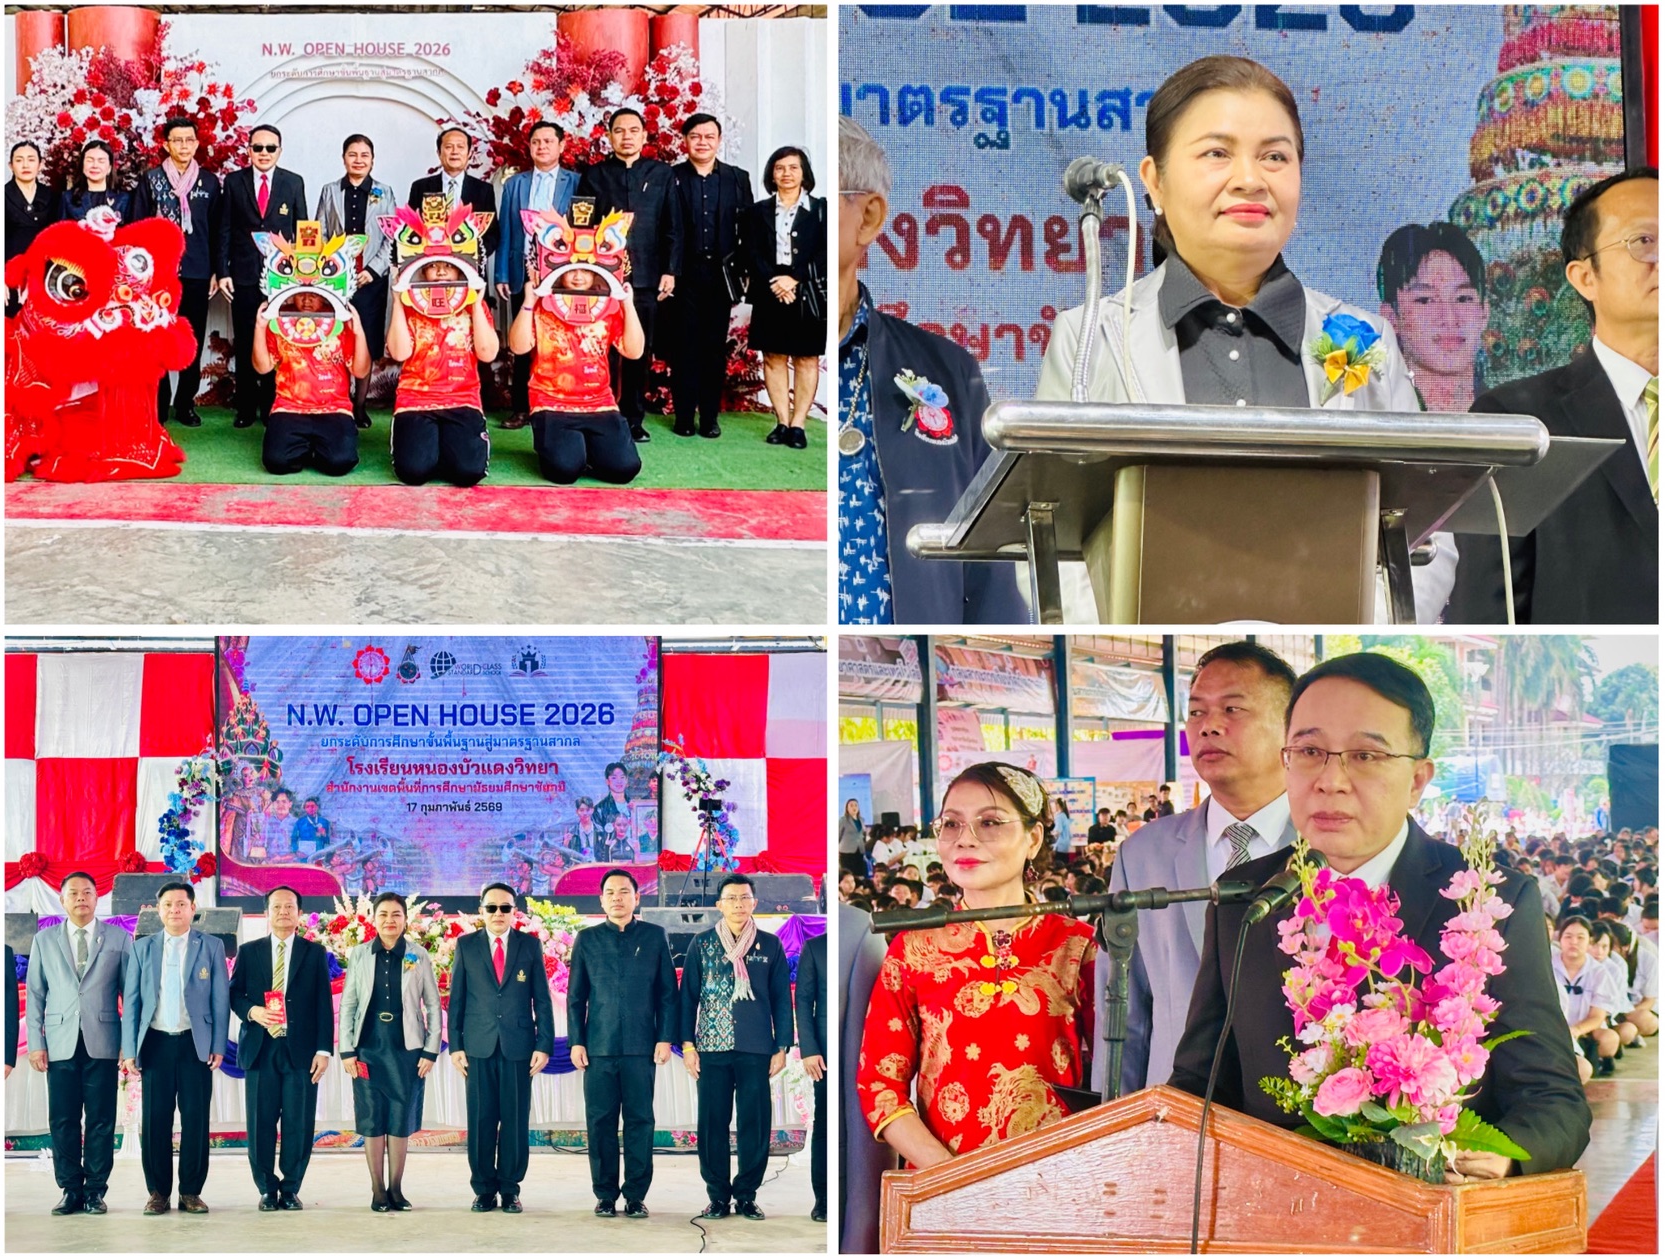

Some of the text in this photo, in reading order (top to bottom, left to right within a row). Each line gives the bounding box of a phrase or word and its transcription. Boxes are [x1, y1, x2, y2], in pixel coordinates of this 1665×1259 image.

[261, 42, 451, 56] N.W. OPEN HOUSE 2026
[841, 83, 1154, 150] าตรฐานส
[858, 185, 1144, 272] งวิทยา
[287, 703, 615, 726] N.W. OPEN HOUSE 2026
[346, 757, 559, 775] โรงเรียนหนองบัวแดงวิทยา
[407, 802, 417, 812] 17
[474, 802, 503, 812] 2569
